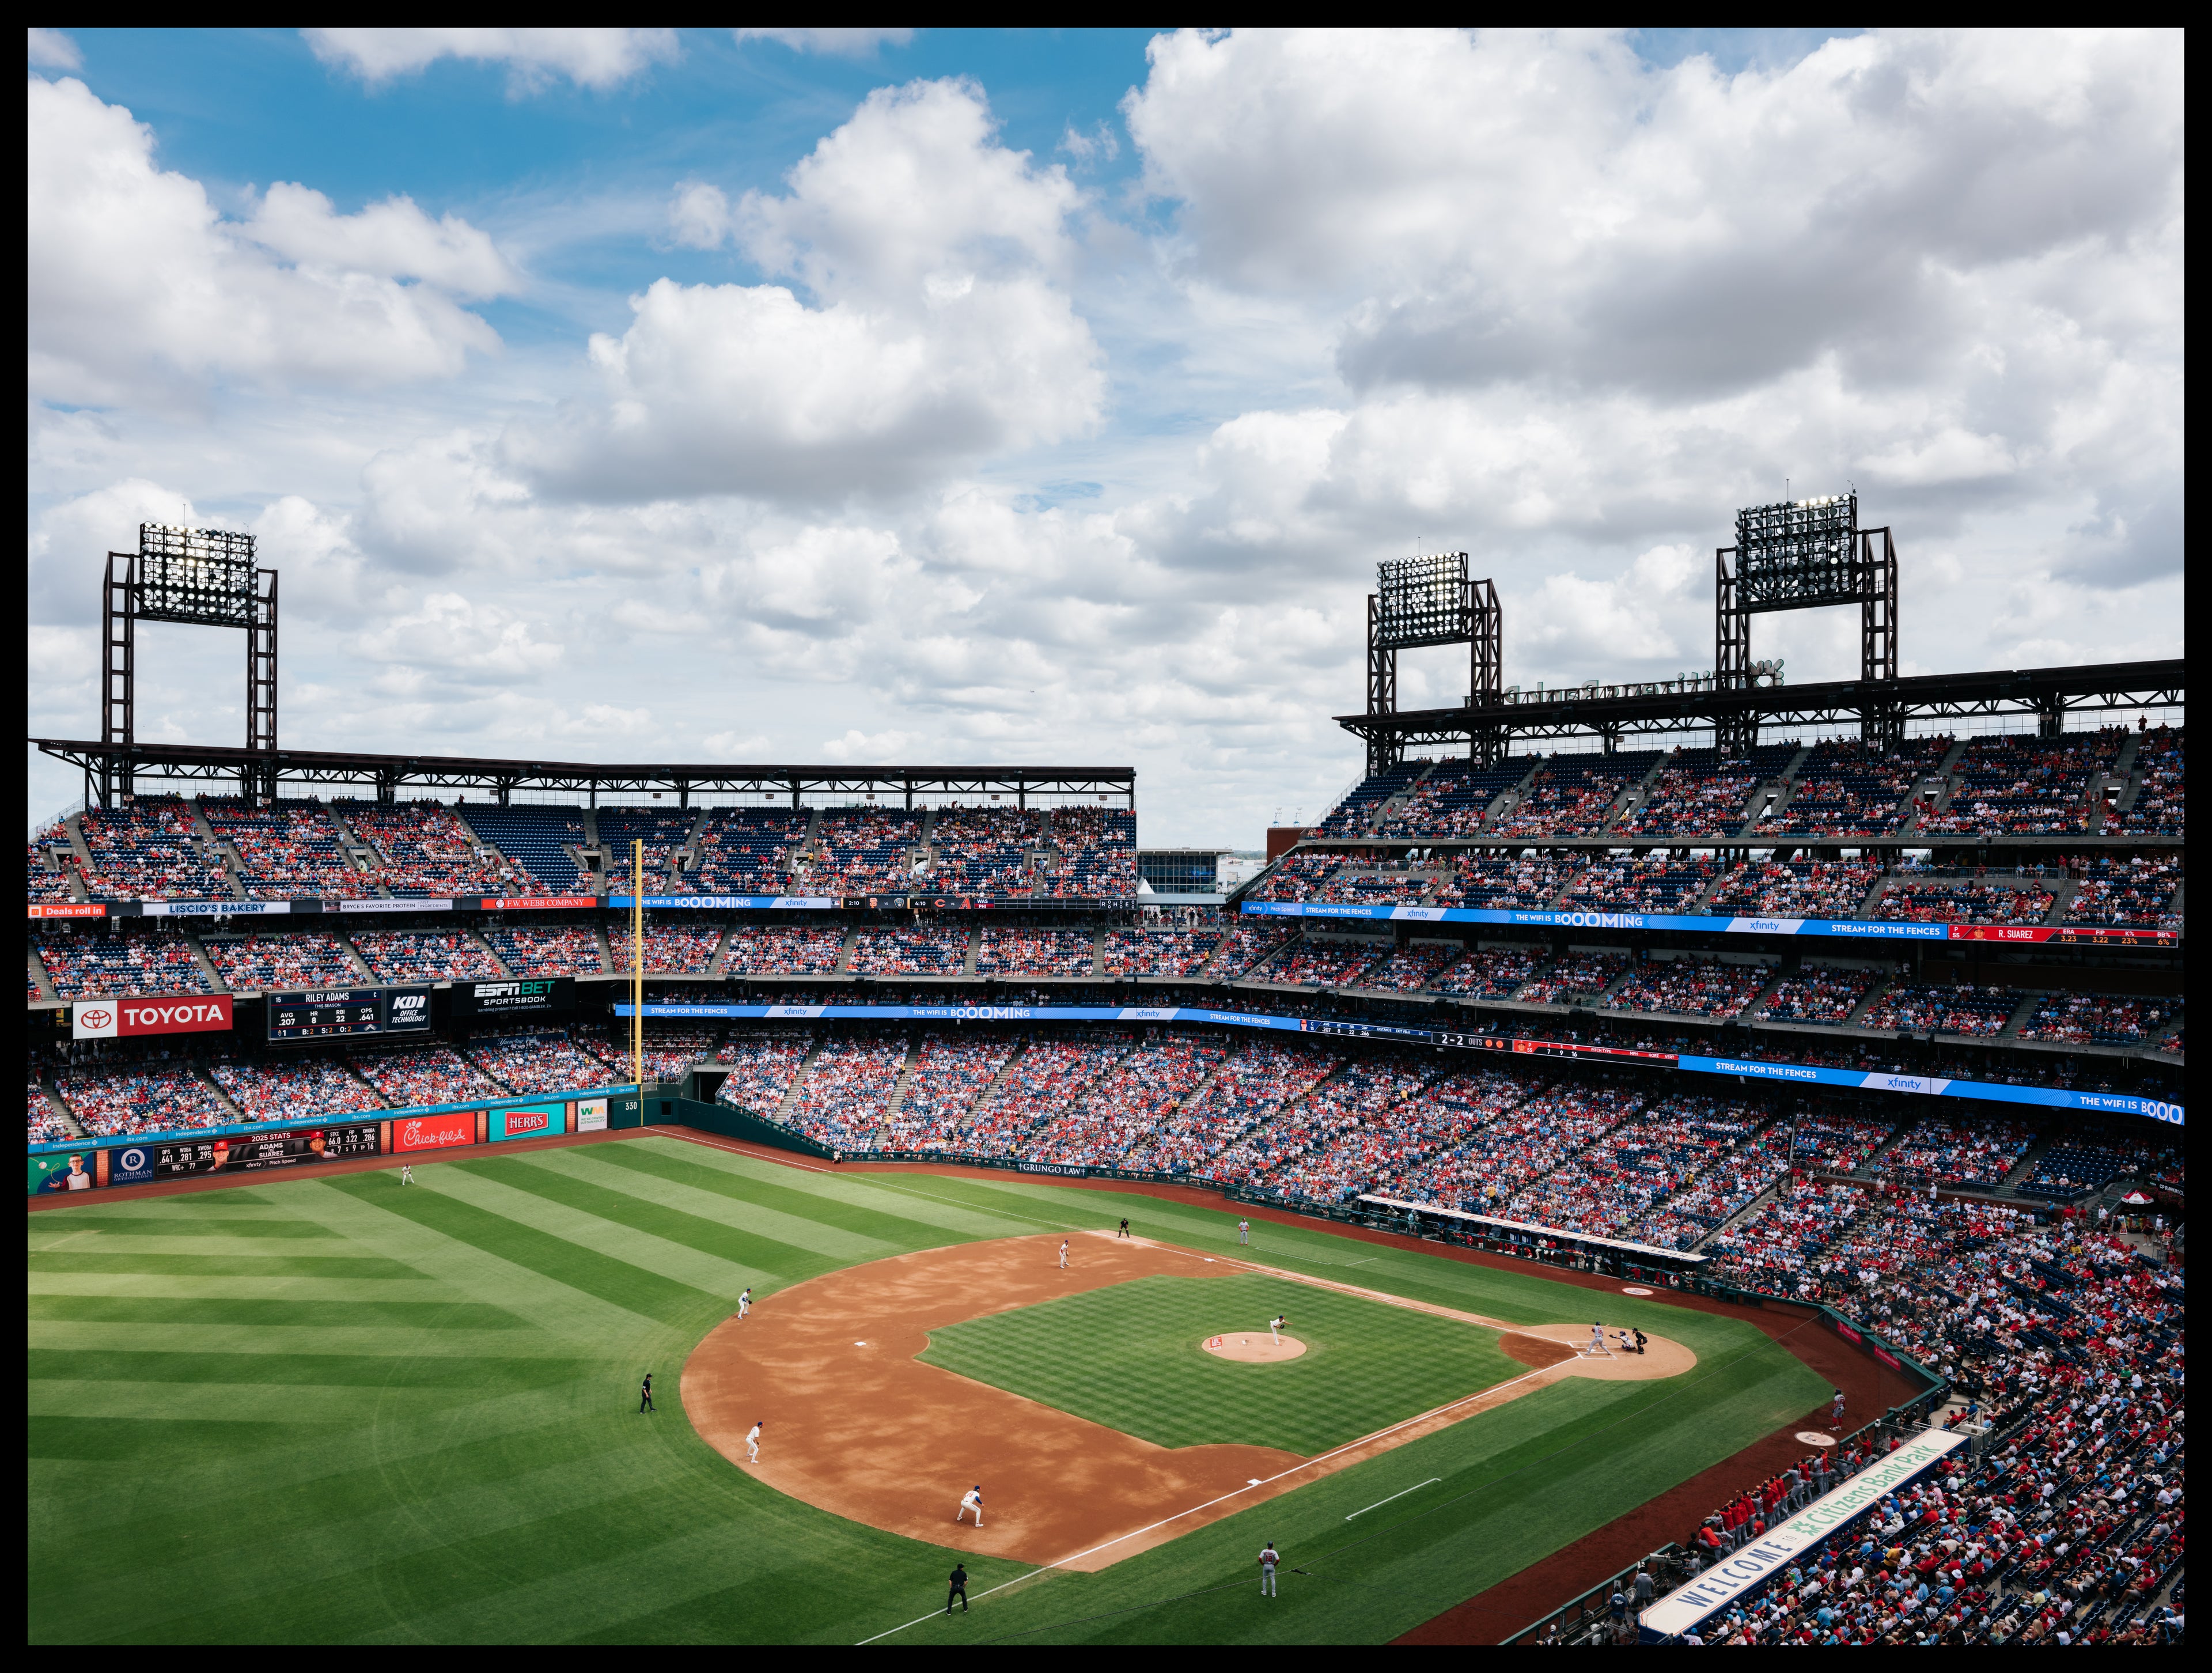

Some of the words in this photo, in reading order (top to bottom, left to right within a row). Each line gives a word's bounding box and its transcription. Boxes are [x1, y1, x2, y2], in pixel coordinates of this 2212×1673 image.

[675, 896, 751, 908] BOOOMING
[47, 907, 73, 915] Deals
[169, 904, 218, 914] LISCIO'S
[221, 903, 267, 913] BAKERY
[1407, 910, 1428, 918] xfinity
[1555, 912, 1642, 928] BOOOMING
[1750, 920, 1779, 930] xfinity
[1832, 925, 1866, 933] STREAM
[1907, 927, 1940, 936] FENCES
[1998, 930, 2005, 938] R.
[2007, 930, 2033, 938] SUAREZ
[474, 983, 520, 997] ESPN
[521, 981, 555, 994] BET
[306, 993, 325, 1002] RILEY
[326, 992, 349, 1001] ADAMS
[483, 996, 546, 1005] SPORTSBOOK
[393, 996, 426, 1009] KDI
[124, 1004, 224, 1026] TOYOTA
[950, 1007, 1030, 1019] BOOOMING
[392, 1015, 426, 1023] TECHNOLOGY
[1469, 1038, 1483, 1046] OUTS
[1716, 1062, 1747, 1072] STREAM
[1750, 1066, 1766, 1074] FOR
[1767, 1068, 1783, 1076] THE
[1785, 1069, 1816, 1078] FENCES
[1888, 1077, 1921, 1090] xfinity
[581, 1106, 604, 1115] WM
[626, 1102, 637, 1110] 330
[2080, 1096, 2100, 1106] THE
[2103, 1099, 2125, 1108] WIFI
[2128, 1101, 2137, 1110] IS
[2141, 1102, 2183, 1125] BOOO
[509, 1115, 543, 1129] HERR'S
[176, 1129, 211, 1137] Independence
[403, 1123, 465, 1146] Chick-fil-A
[52, 1141, 90, 1149] Independence
[328, 1137, 340, 1145] 66.0
[160, 1155, 173, 1164] .641
[179, 1153, 192, 1161] .281
[198, 1150, 211, 1159] .295
[114, 1169, 152, 1178] ROTHMAN
[1023, 1164, 1061, 1174] GRUNGO
[2165, 1186, 2179, 1194] RANKIN
[1648, 1248, 1687, 1258] HOME
[1806, 1486, 1878, 1524] Citizens
[1860, 1460, 1912, 1488] Bank
[1893, 1443, 1940, 1470] Park
[1676, 1540, 1793, 1608] WELCOME
